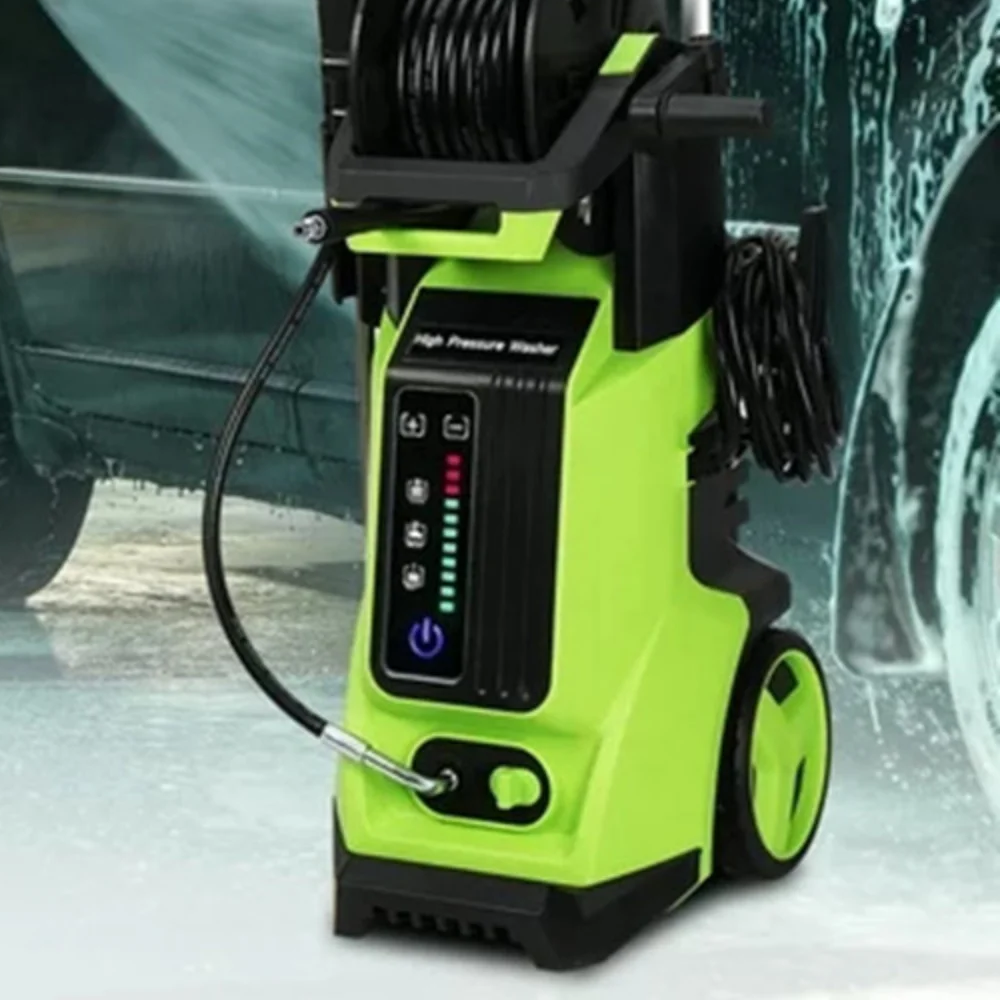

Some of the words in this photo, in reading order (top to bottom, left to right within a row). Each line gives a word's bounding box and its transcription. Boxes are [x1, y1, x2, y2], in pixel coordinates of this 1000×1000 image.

[413, 333, 444, 349] High
[447, 334, 505, 352] Pressure
[509, 339, 560, 356] Washer
